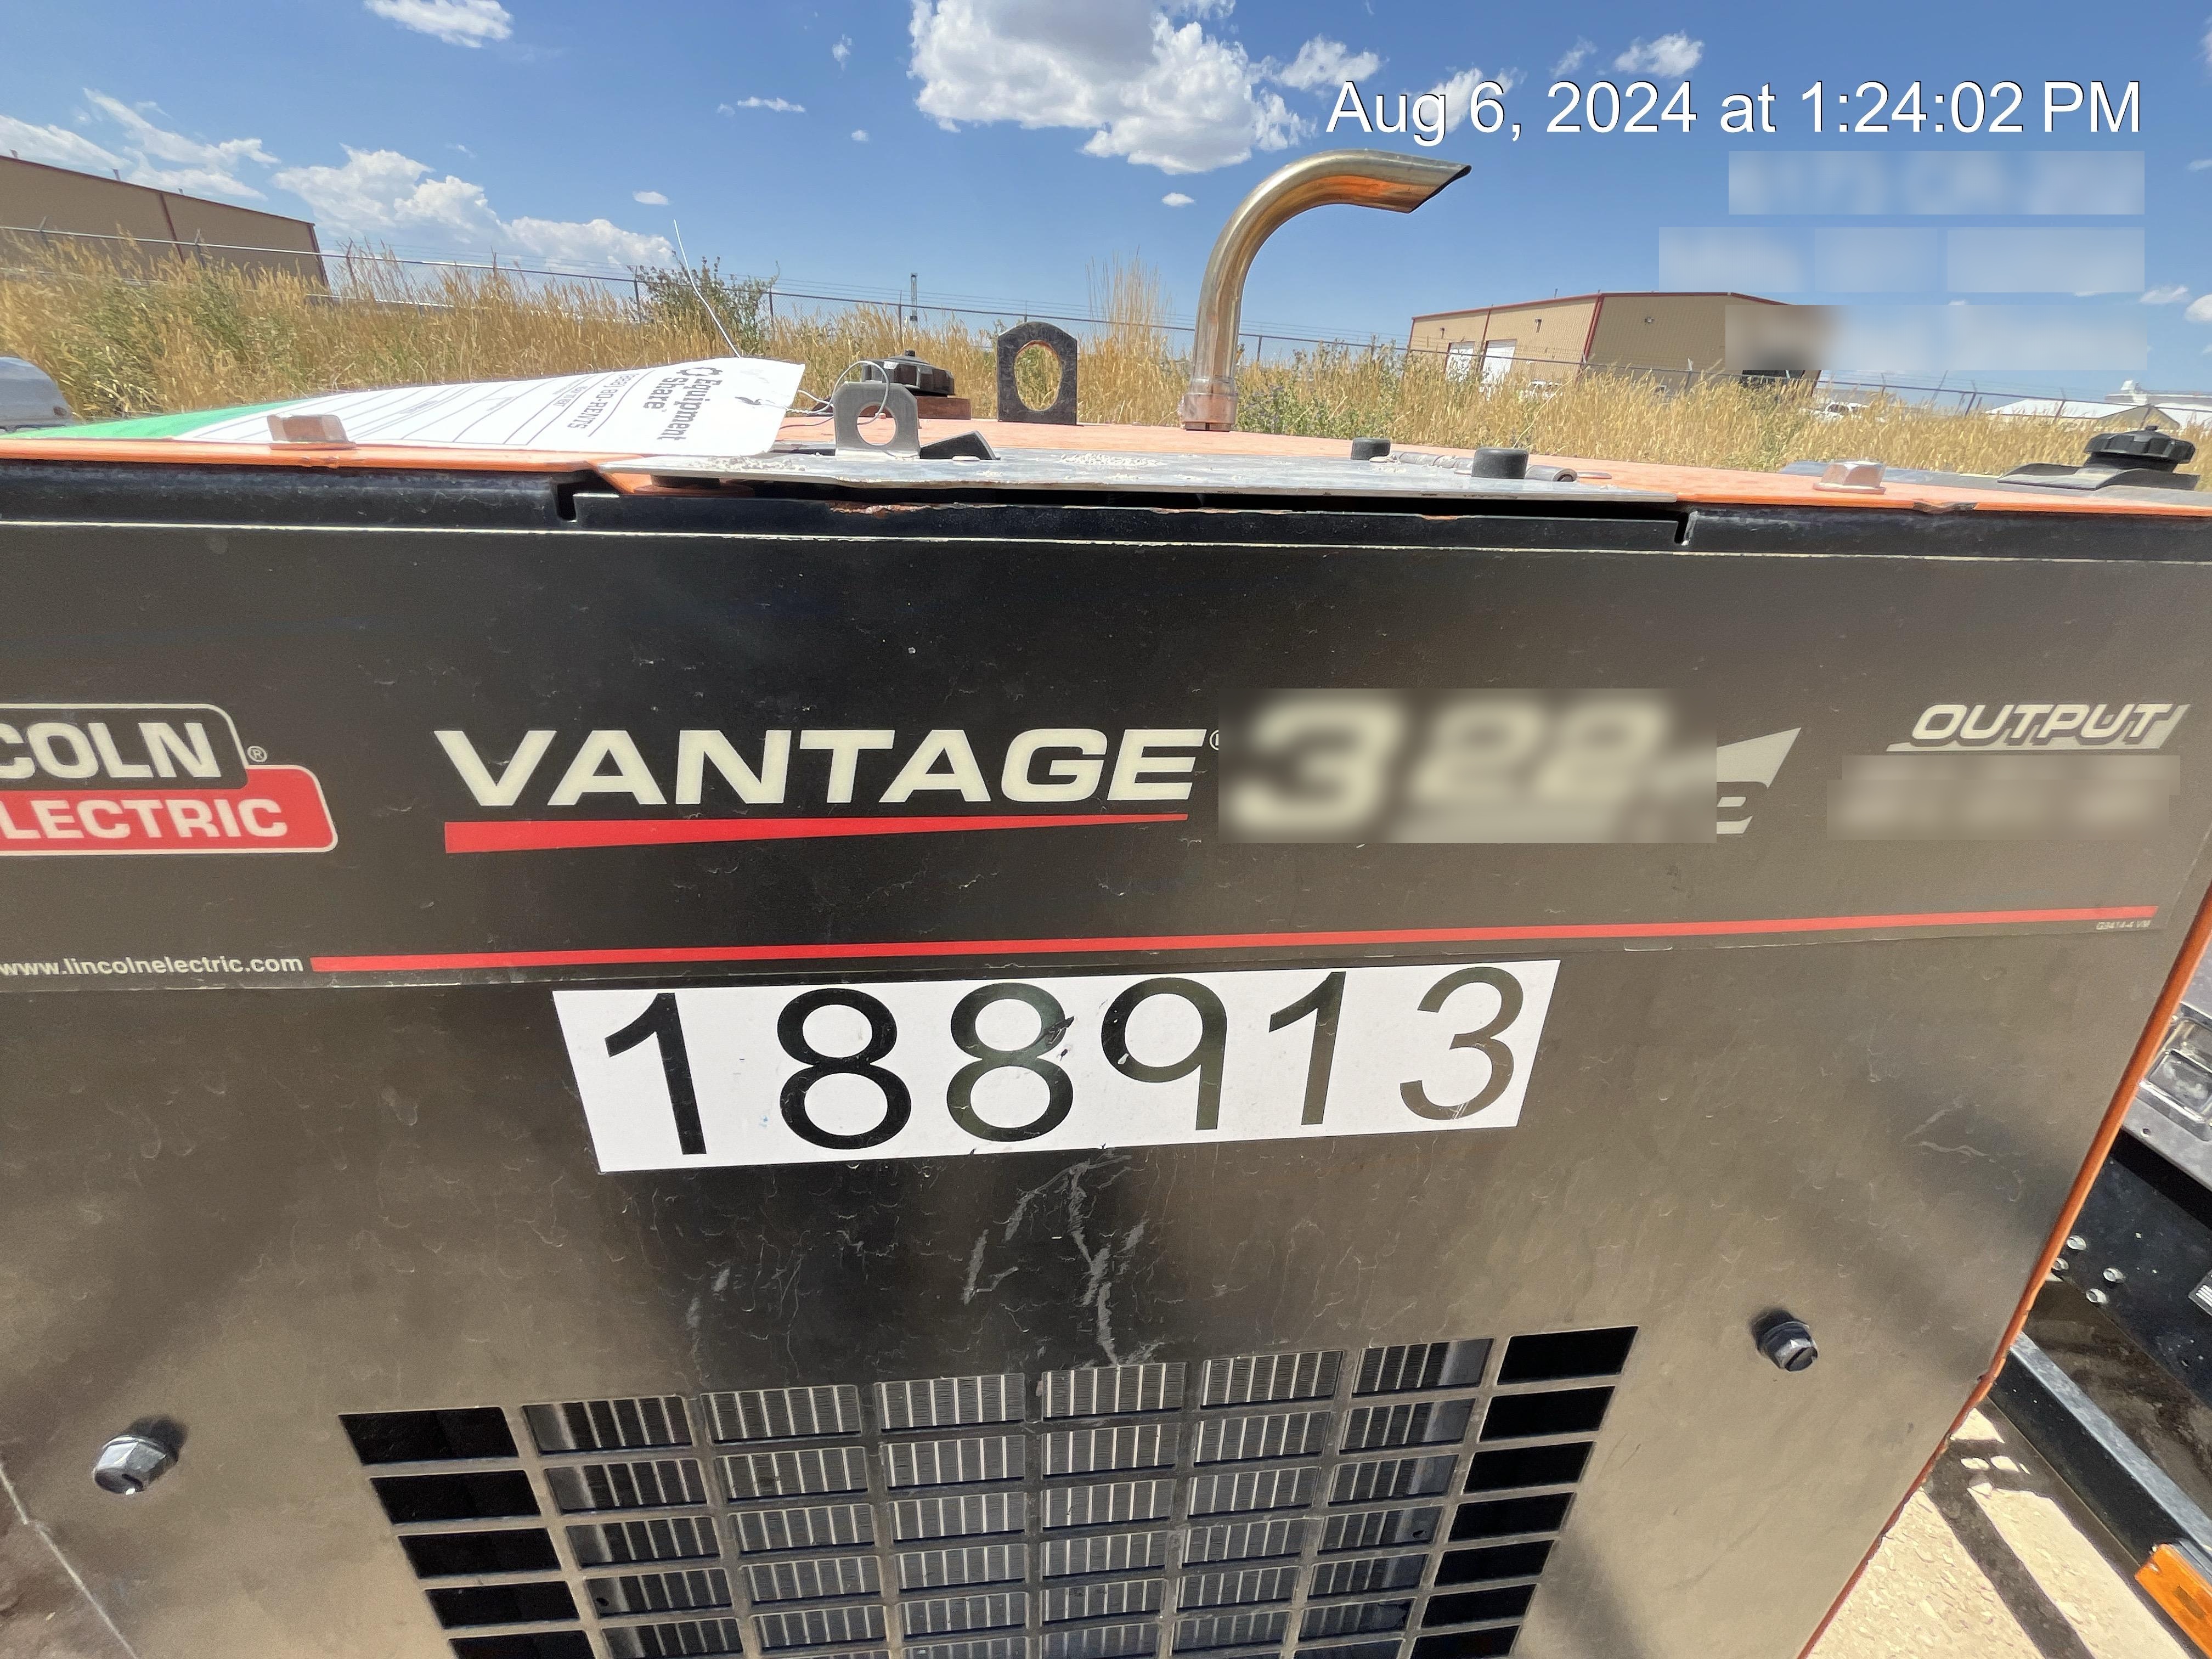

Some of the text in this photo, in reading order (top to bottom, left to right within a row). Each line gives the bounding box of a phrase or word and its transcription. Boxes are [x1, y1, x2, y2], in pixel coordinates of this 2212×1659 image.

[567, 389, 619, 429] 80-RENTS
[643, 377, 689, 409] Share
[657, 379, 723, 441] Equipment
[1911, 703, 2173, 740] OUTPUT
[434, 729, 1207, 806] VANTAGE
[0, 956, 304, 977] www.lincolnelectric.com
[603, 966, 1525, 1156] 188913
